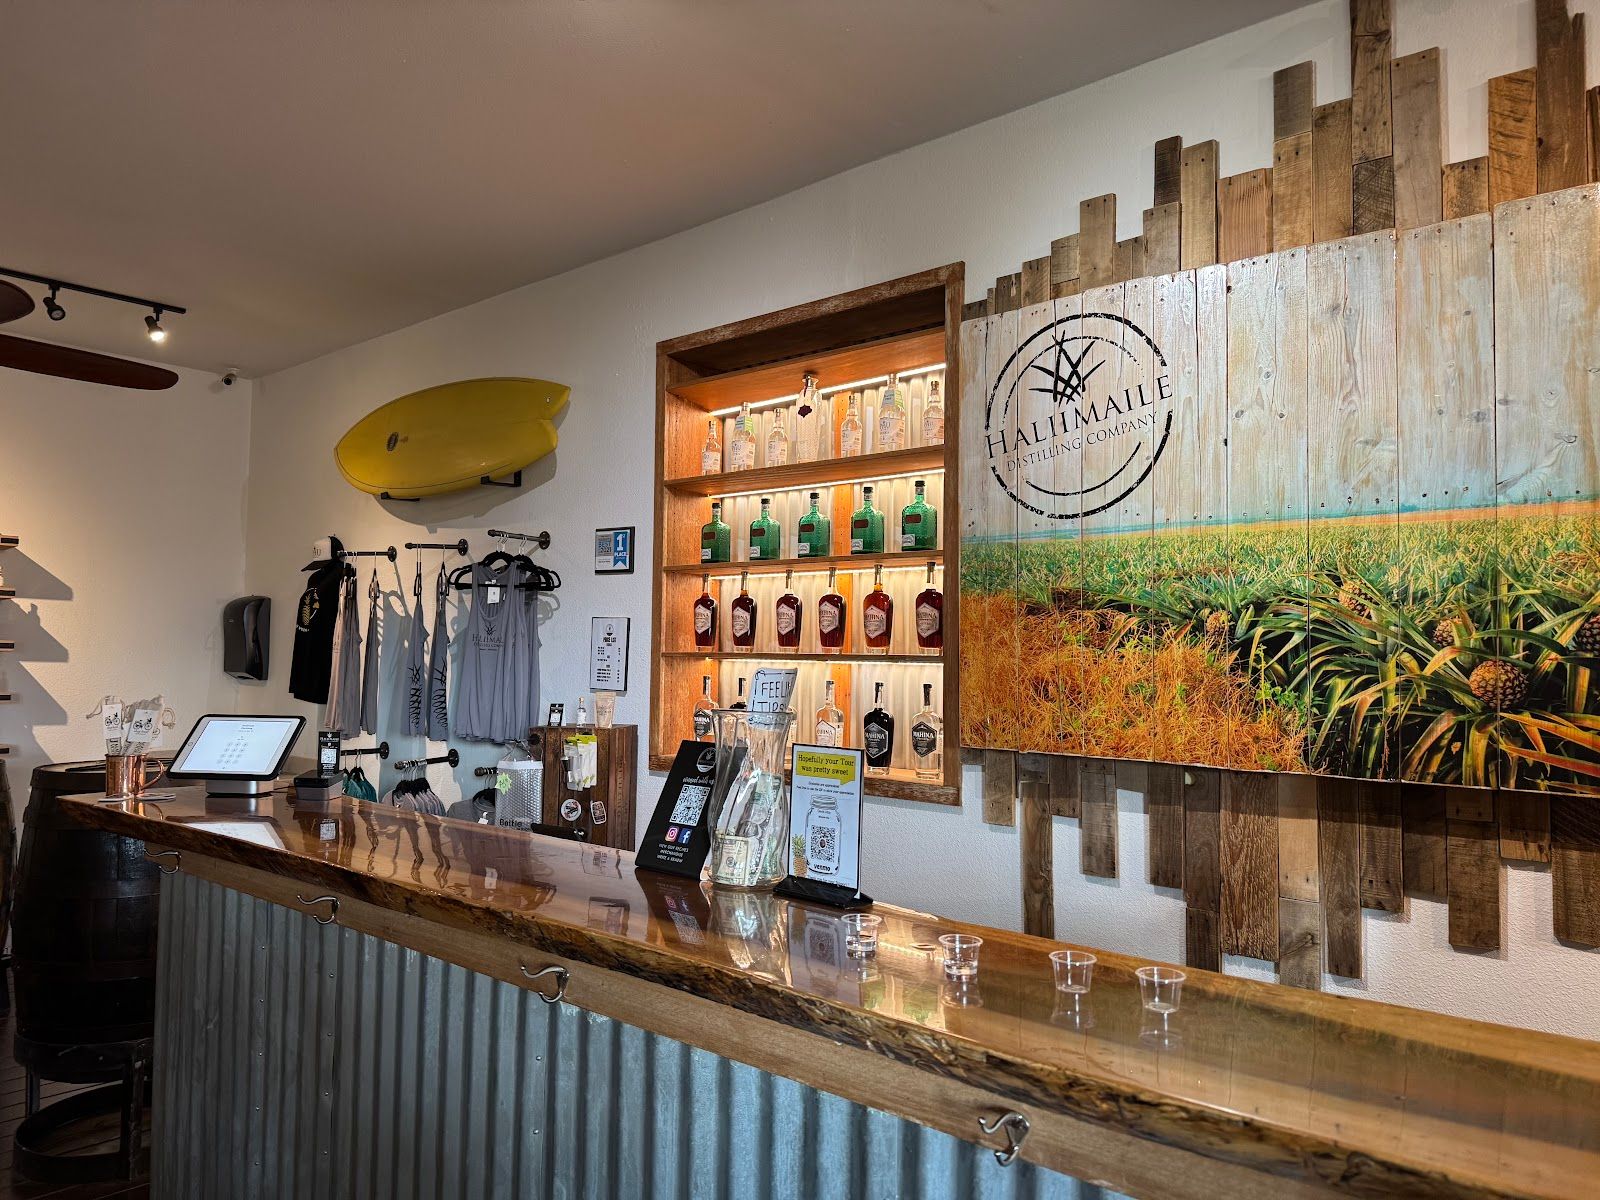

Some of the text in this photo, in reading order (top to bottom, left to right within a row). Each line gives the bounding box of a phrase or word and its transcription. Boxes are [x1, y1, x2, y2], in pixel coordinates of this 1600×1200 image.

[985, 374, 1173, 459] HALIIMAILE
[1006, 411, 1159, 473] DISTILLING COMPANY
[798, 754, 855, 767] Hopefully your Tour
[813, 765, 831, 775] pretty
[813, 863, 831, 872] venmo
